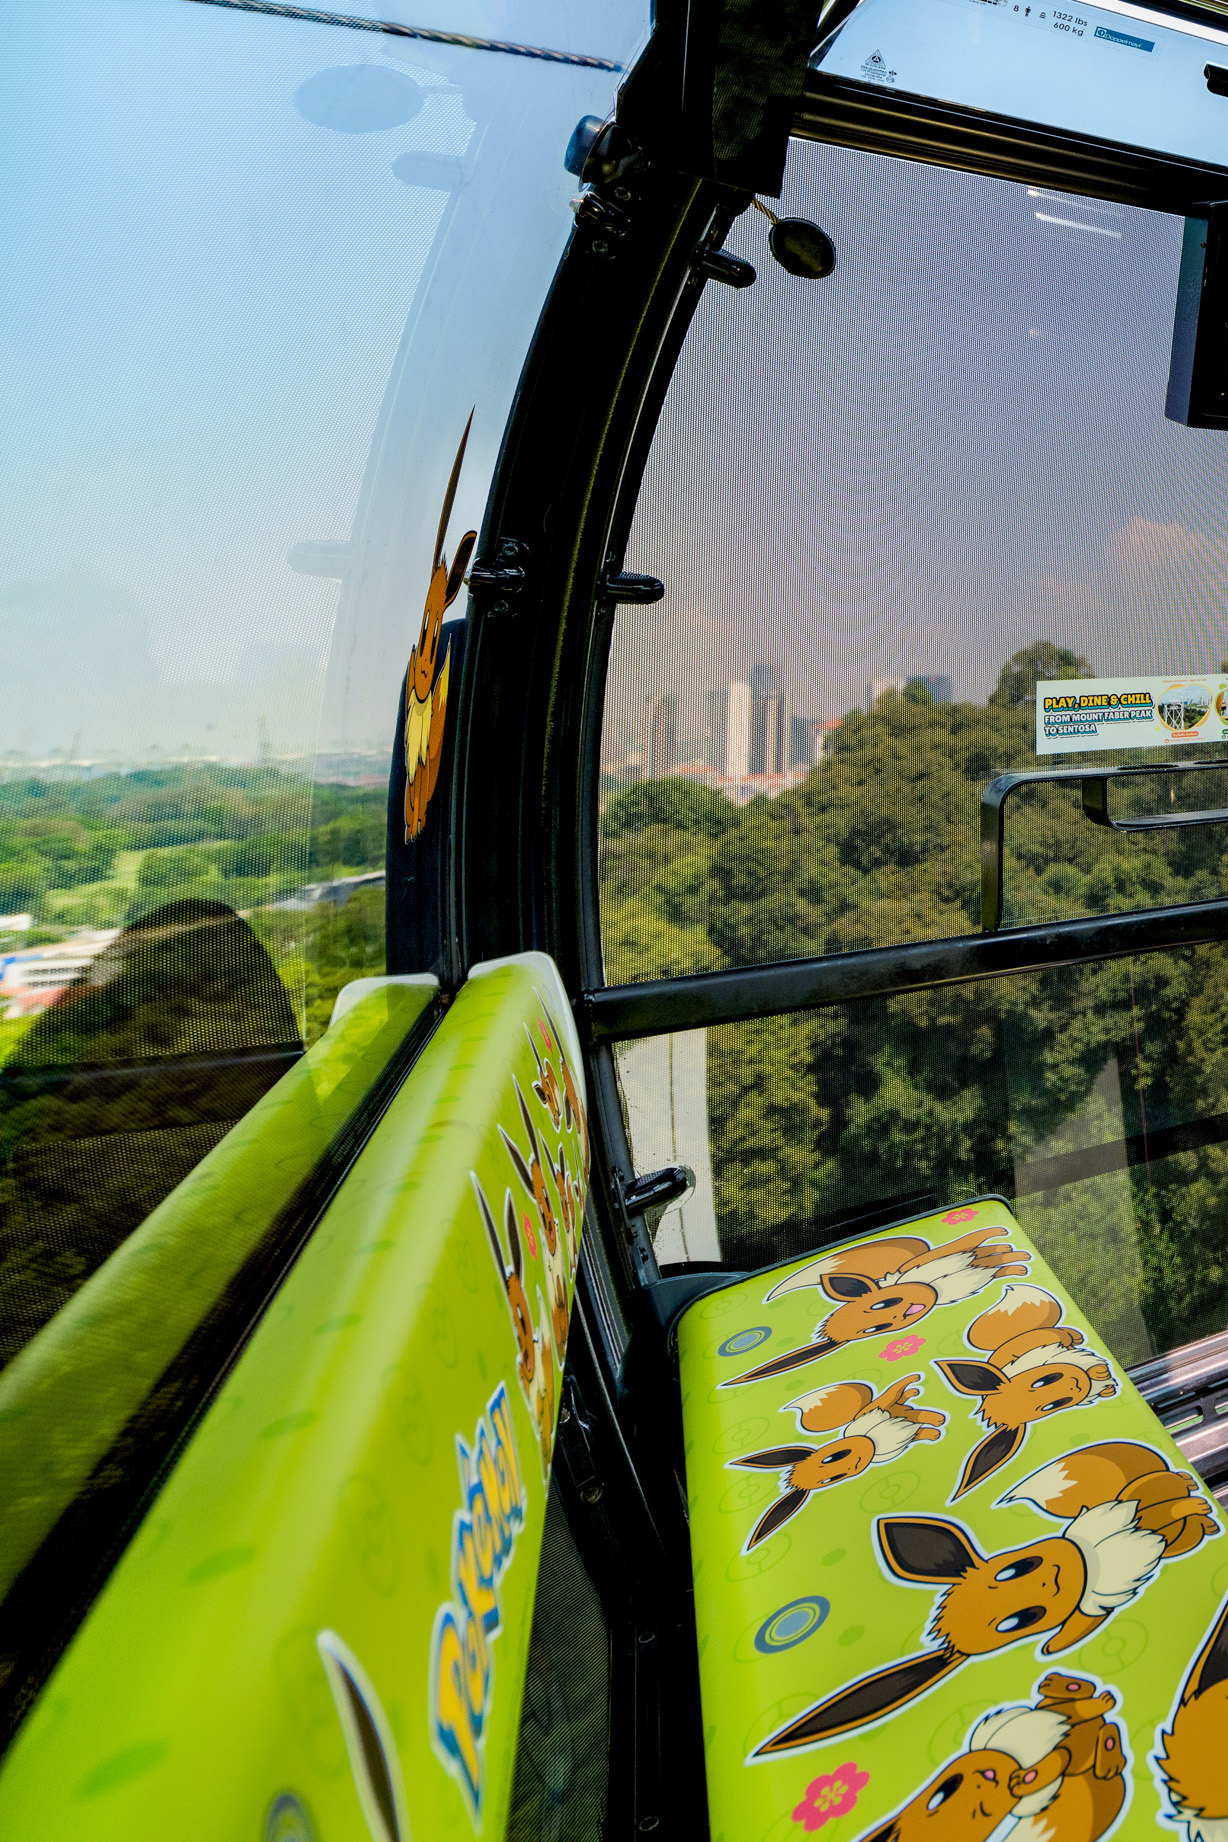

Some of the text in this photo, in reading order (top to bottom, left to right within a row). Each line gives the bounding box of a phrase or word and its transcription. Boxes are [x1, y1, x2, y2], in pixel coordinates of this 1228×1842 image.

[1013, 4, 1019, 12] 8
[1052, 10, 1088, 27] 1322 lbs
[1053, 22, 1084, 37] 600 kg
[1044, 692, 1152, 710] PLAY, DINE & CHILL
[1044, 710, 1152, 725] FROM MOUNT FABER PEAK
[1044, 724, 1096, 736] TO SENTOSA
